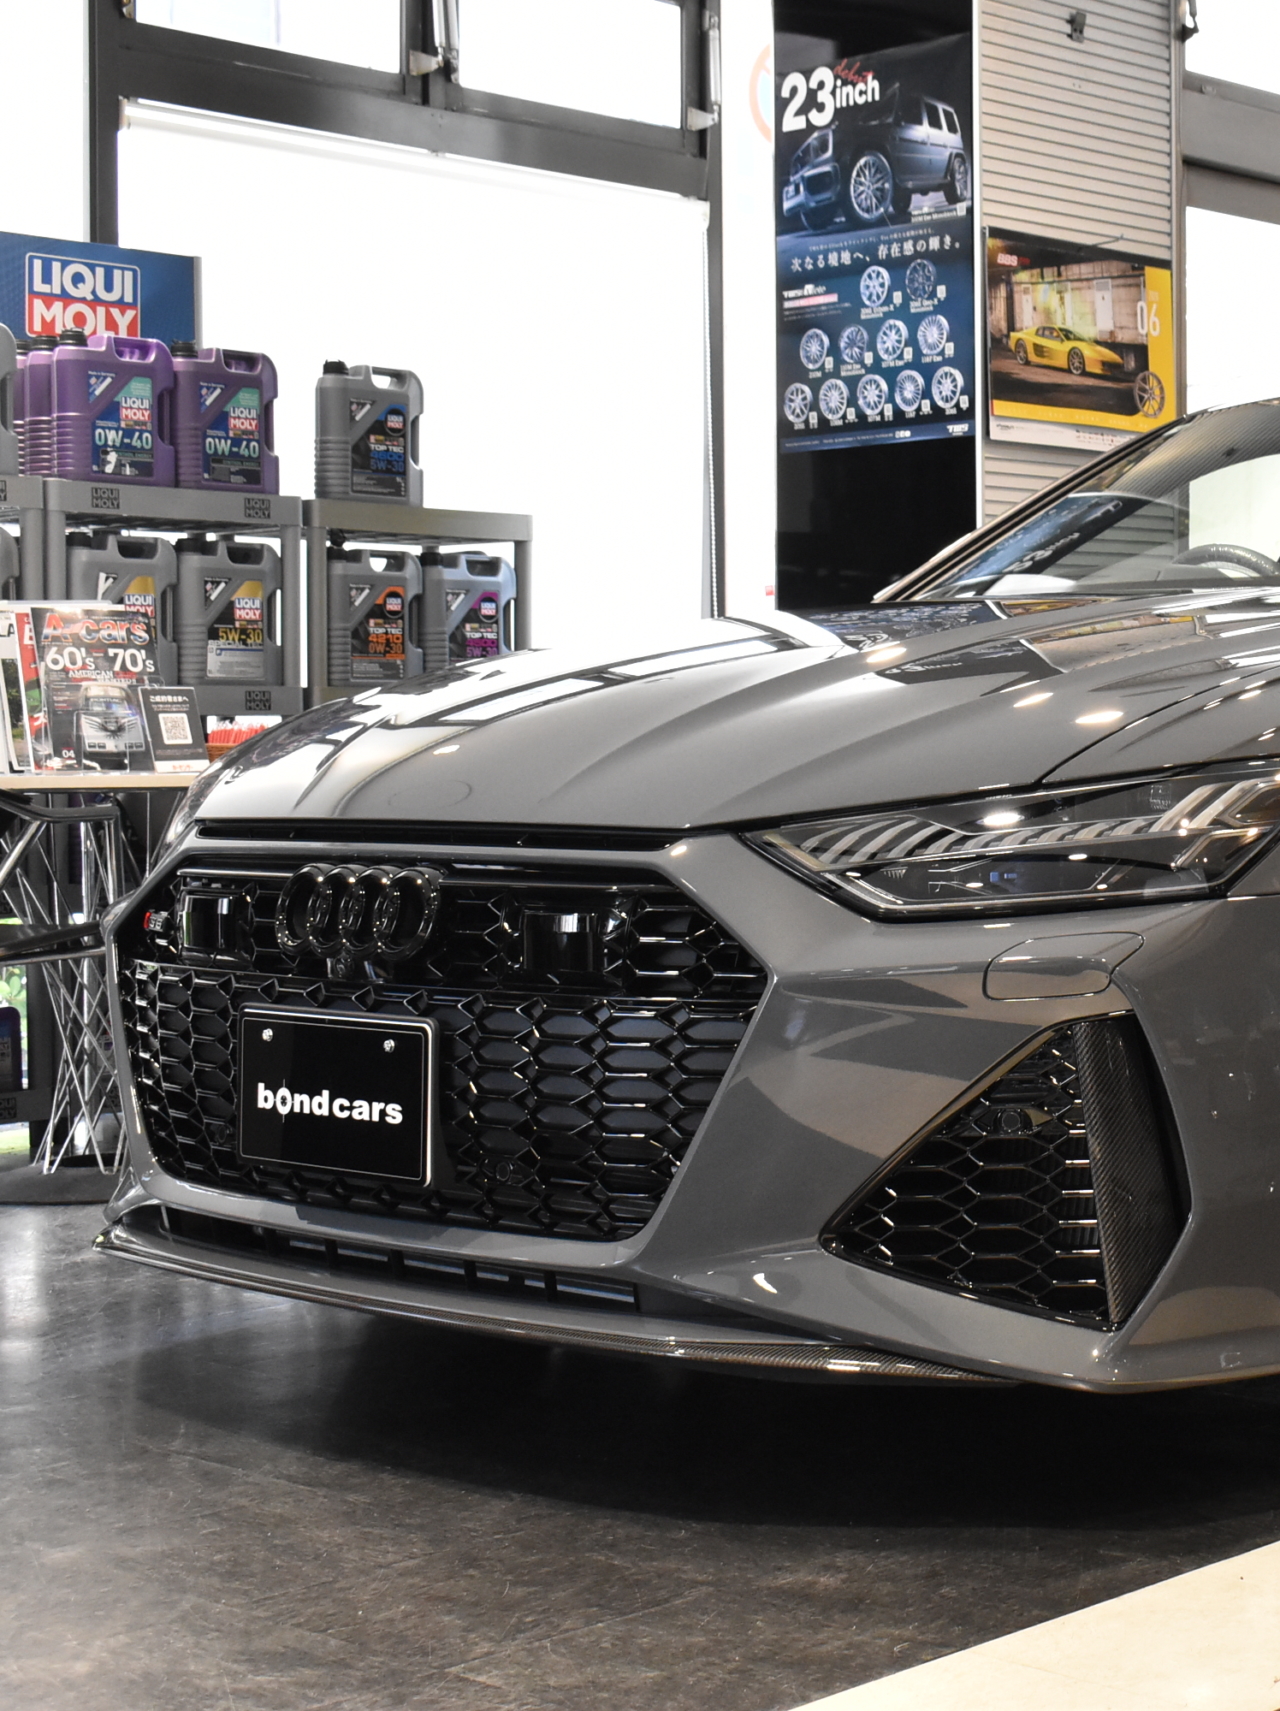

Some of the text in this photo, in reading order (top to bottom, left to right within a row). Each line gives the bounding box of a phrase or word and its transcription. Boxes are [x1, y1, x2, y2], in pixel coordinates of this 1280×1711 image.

[997, 252, 1018, 267] BBS
[33, 258, 133, 303] LIQUI
[33, 298, 137, 337] MOLY
[1137, 301, 1160, 337] 06
[121, 396, 149, 409] LIQUI
[122, 409, 151, 421] MOLY
[230, 406, 257, 419] LIQUI
[230, 418, 258, 431] MOLY
[95, 428, 152, 450] 0W-40
[205, 437, 259, 458] 0W-40
[93, 488, 119, 498] LIQUI
[93, 498, 119, 509] MOLY
[124, 595, 152, 605] LIQUI
[235, 598, 260, 609] LIQUI
[235, 608, 261, 620] MOLY
[219, 627, 262, 643] 5W-30
[368, 634, 403, 643] 4210
[368, 643, 403, 655] 0W-30
[466, 647, 499, 658] 5W-30
[46, 646, 155, 673] 60's 70's
[68, 670, 114, 679] AMERICAN
[62, 749, 76, 759] 04
